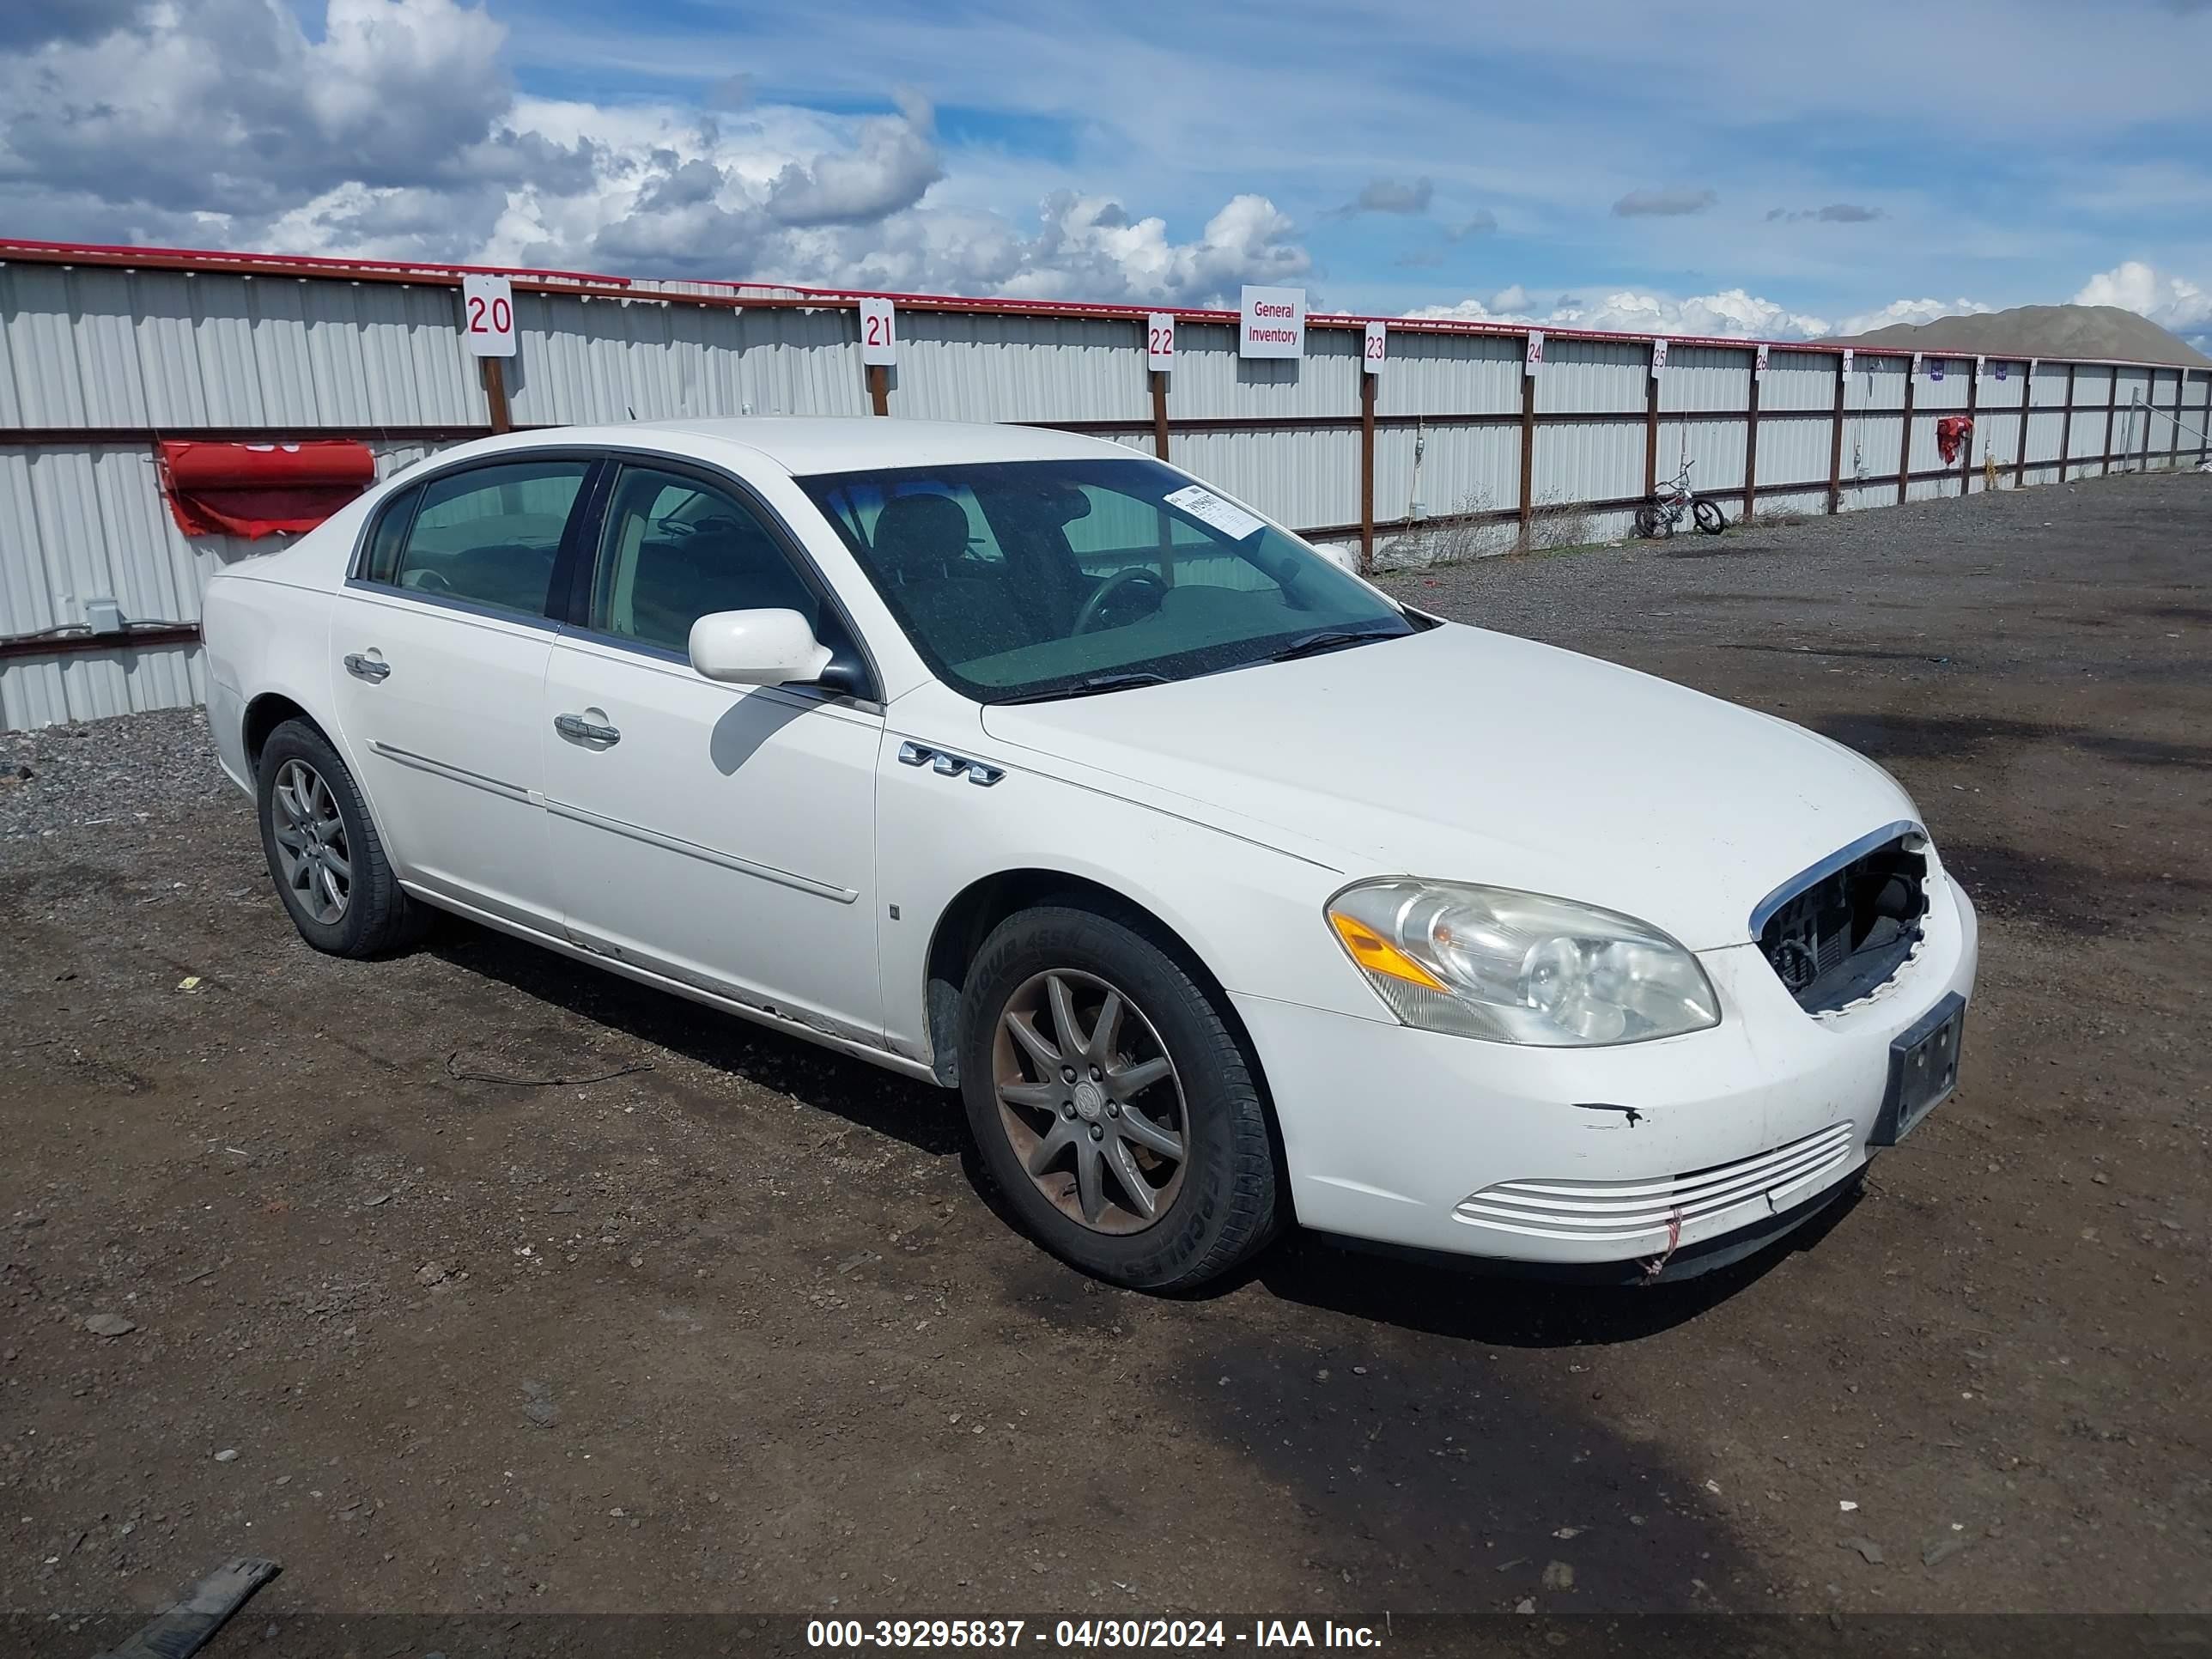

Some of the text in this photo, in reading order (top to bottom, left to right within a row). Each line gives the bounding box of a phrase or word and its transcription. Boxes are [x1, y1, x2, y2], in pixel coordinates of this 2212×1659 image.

[468, 296, 511, 334] 20
[1254, 301, 1294, 319] General
[866, 315, 890, 346] 21
[1249, 325, 1297, 345] Inventory
[1150, 328, 1172, 355] 22
[1367, 336, 1383, 359] 23
[1528, 343, 1541, 364] 24
[1654, 349, 1665, 368] 25
[1756, 354, 1767, 371] 26
[1843, 357, 1853, 373] 27
